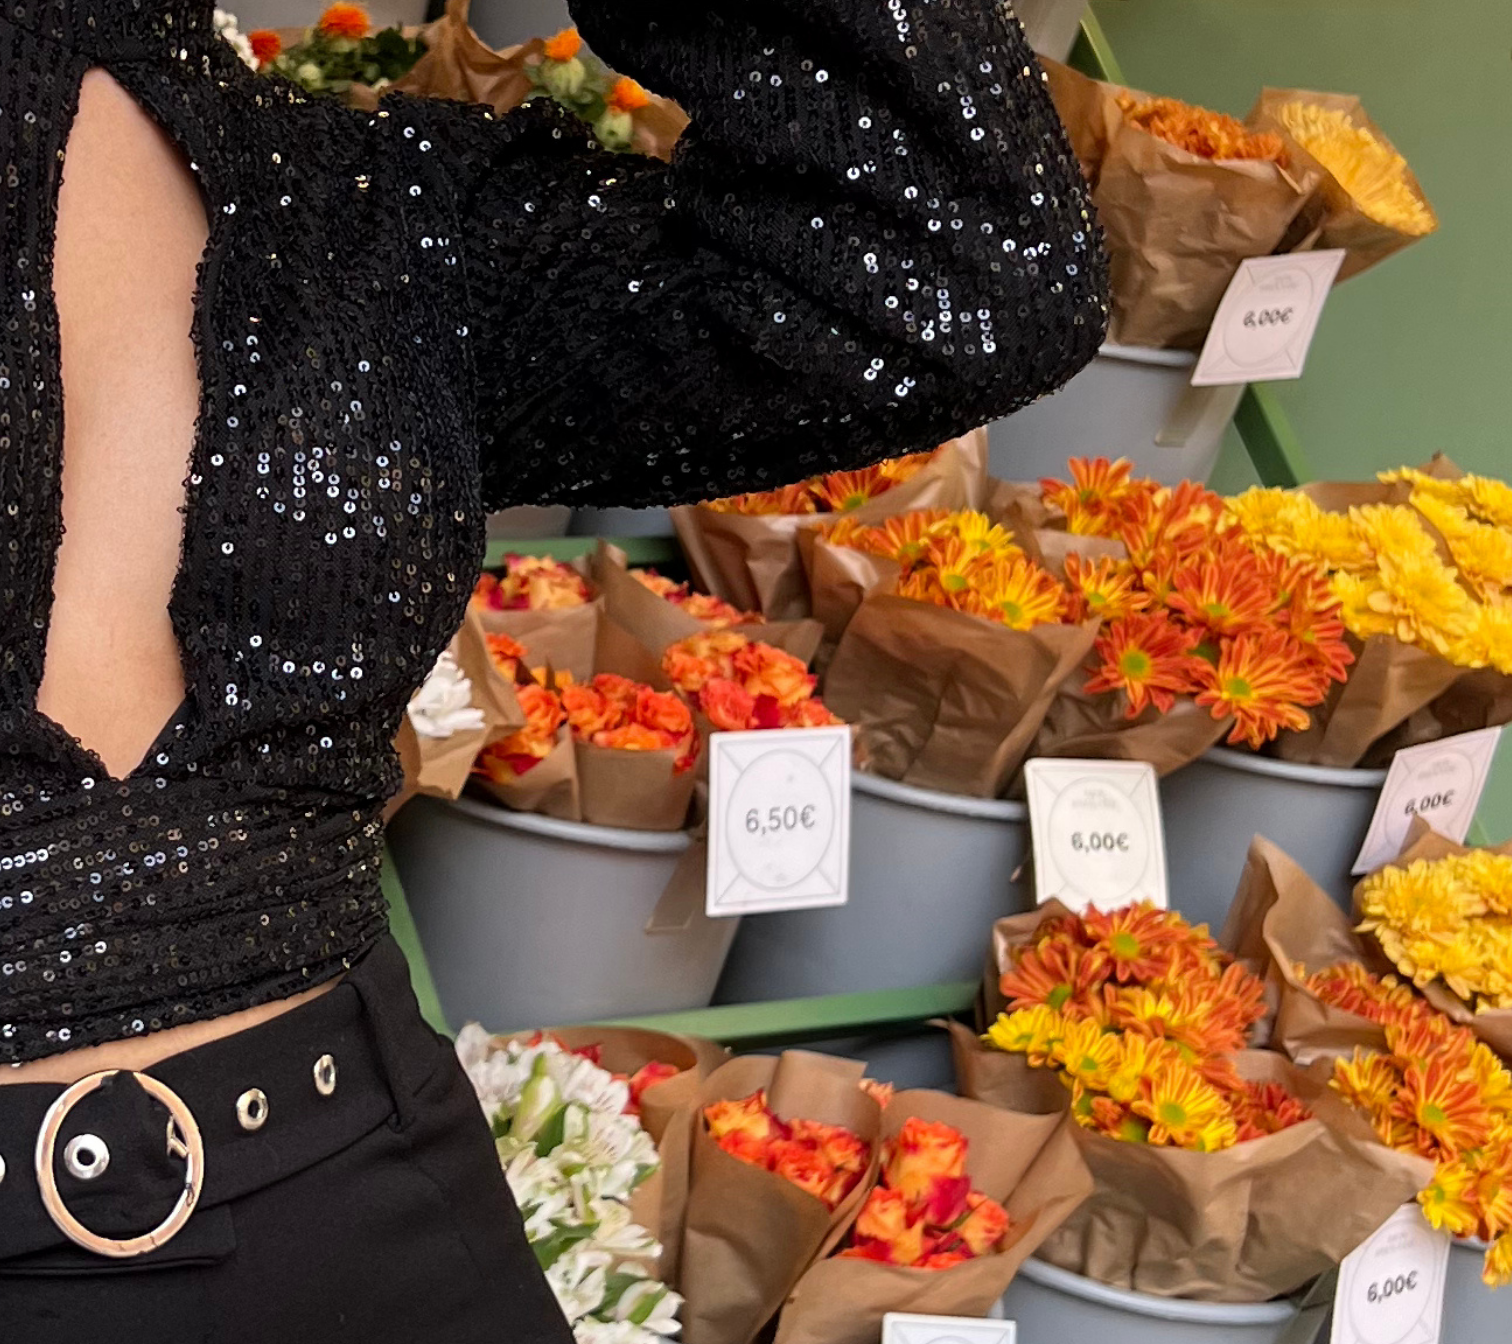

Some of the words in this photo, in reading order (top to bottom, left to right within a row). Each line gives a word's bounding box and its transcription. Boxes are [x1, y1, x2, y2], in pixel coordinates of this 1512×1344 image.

[745, 805, 816, 836] 6,50€
[1071, 831, 1130, 854] 6,00€
[1366, 1270, 1419, 1304] 6,00€
